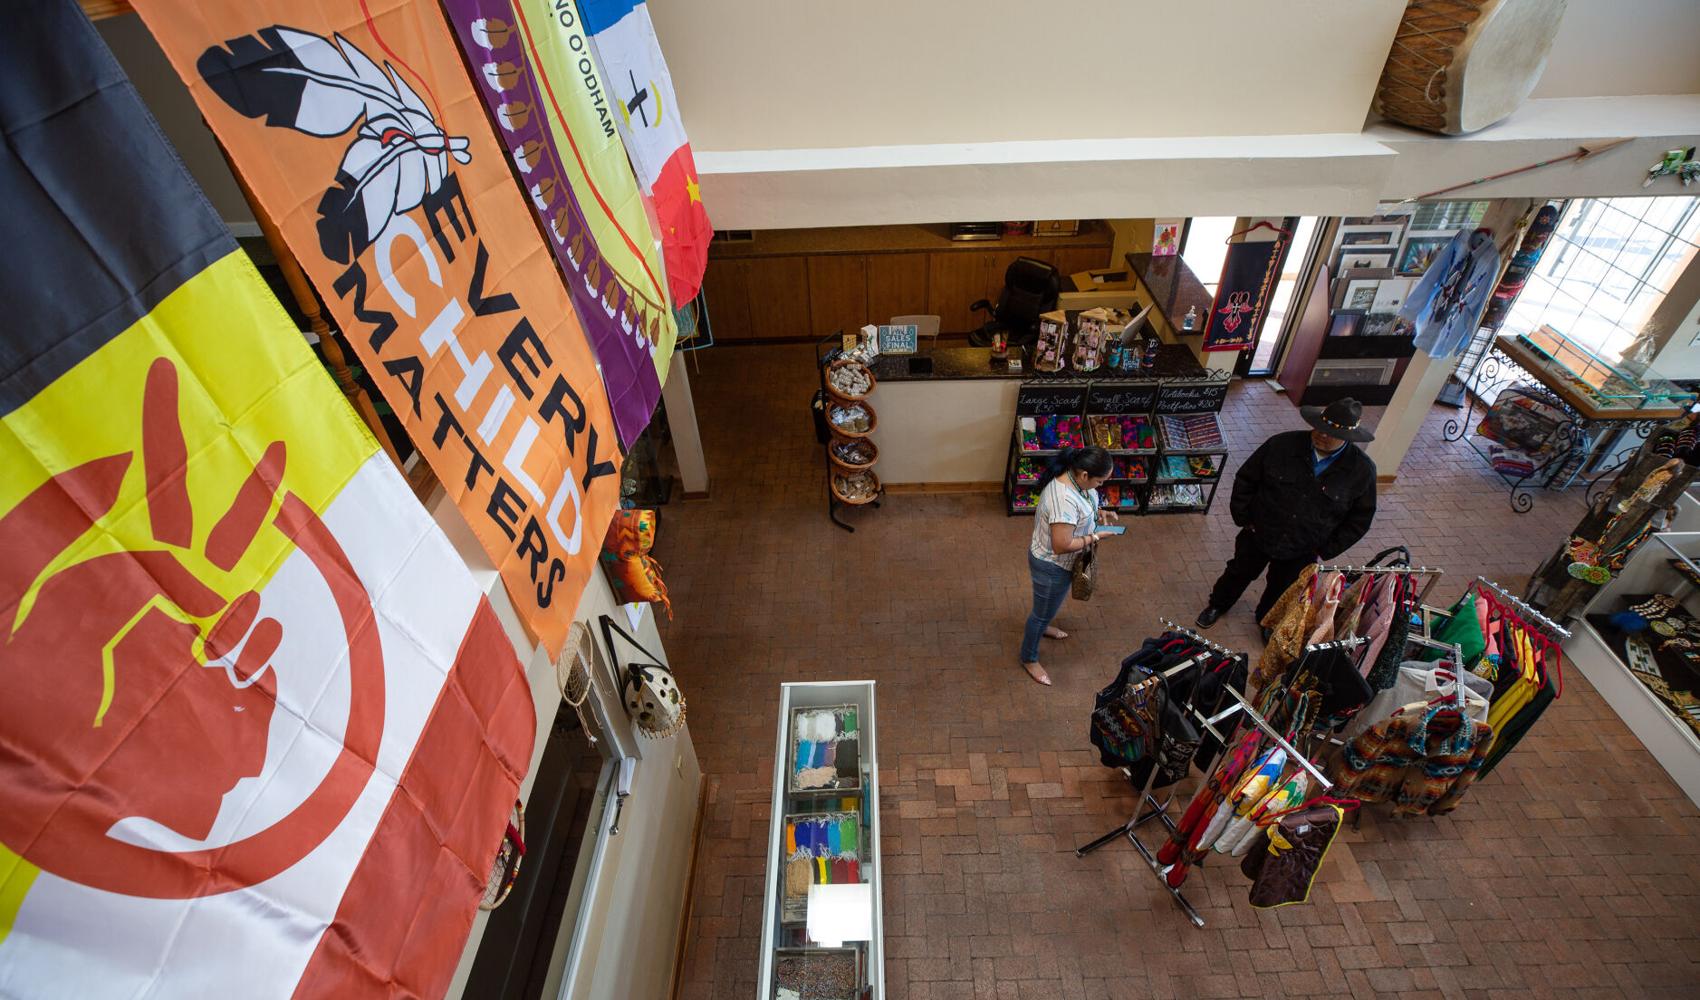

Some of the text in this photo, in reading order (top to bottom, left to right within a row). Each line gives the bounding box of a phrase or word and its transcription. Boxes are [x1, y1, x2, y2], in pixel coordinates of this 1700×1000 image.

[332, 259, 566, 608] MATTERS
[374, 213, 582, 555] CHILD
[422, 174, 617, 493] EVERY
[1020, 394, 1048, 405] Large
[1090, 392, 1121, 404] Small
